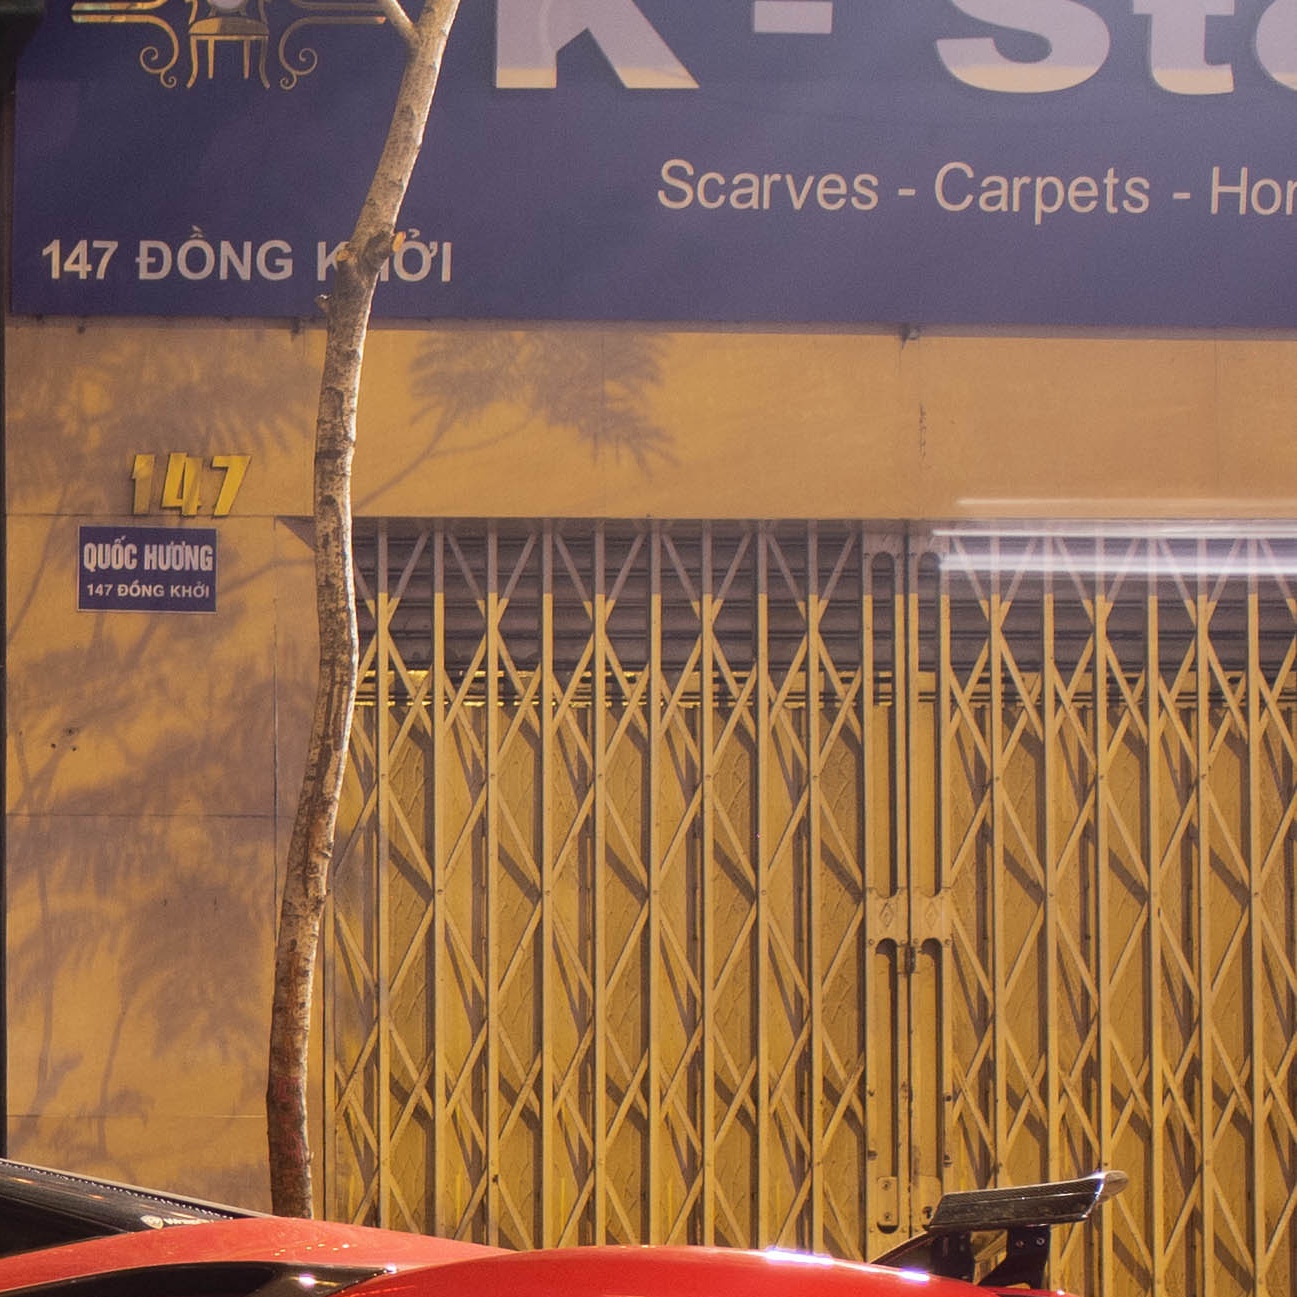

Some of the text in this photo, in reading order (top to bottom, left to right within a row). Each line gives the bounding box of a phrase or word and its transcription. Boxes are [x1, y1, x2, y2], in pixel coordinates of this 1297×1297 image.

[657, 159, 879, 210] Scarves
[933, 162, 1150, 225] Carpets
[42, 224, 453, 282] 147 ĐỒNG KỞI
[131, 452, 252, 516] 147
[83, 535, 214, 572] QUỐC HƯƠNG
[87, 584, 113, 596] 147
